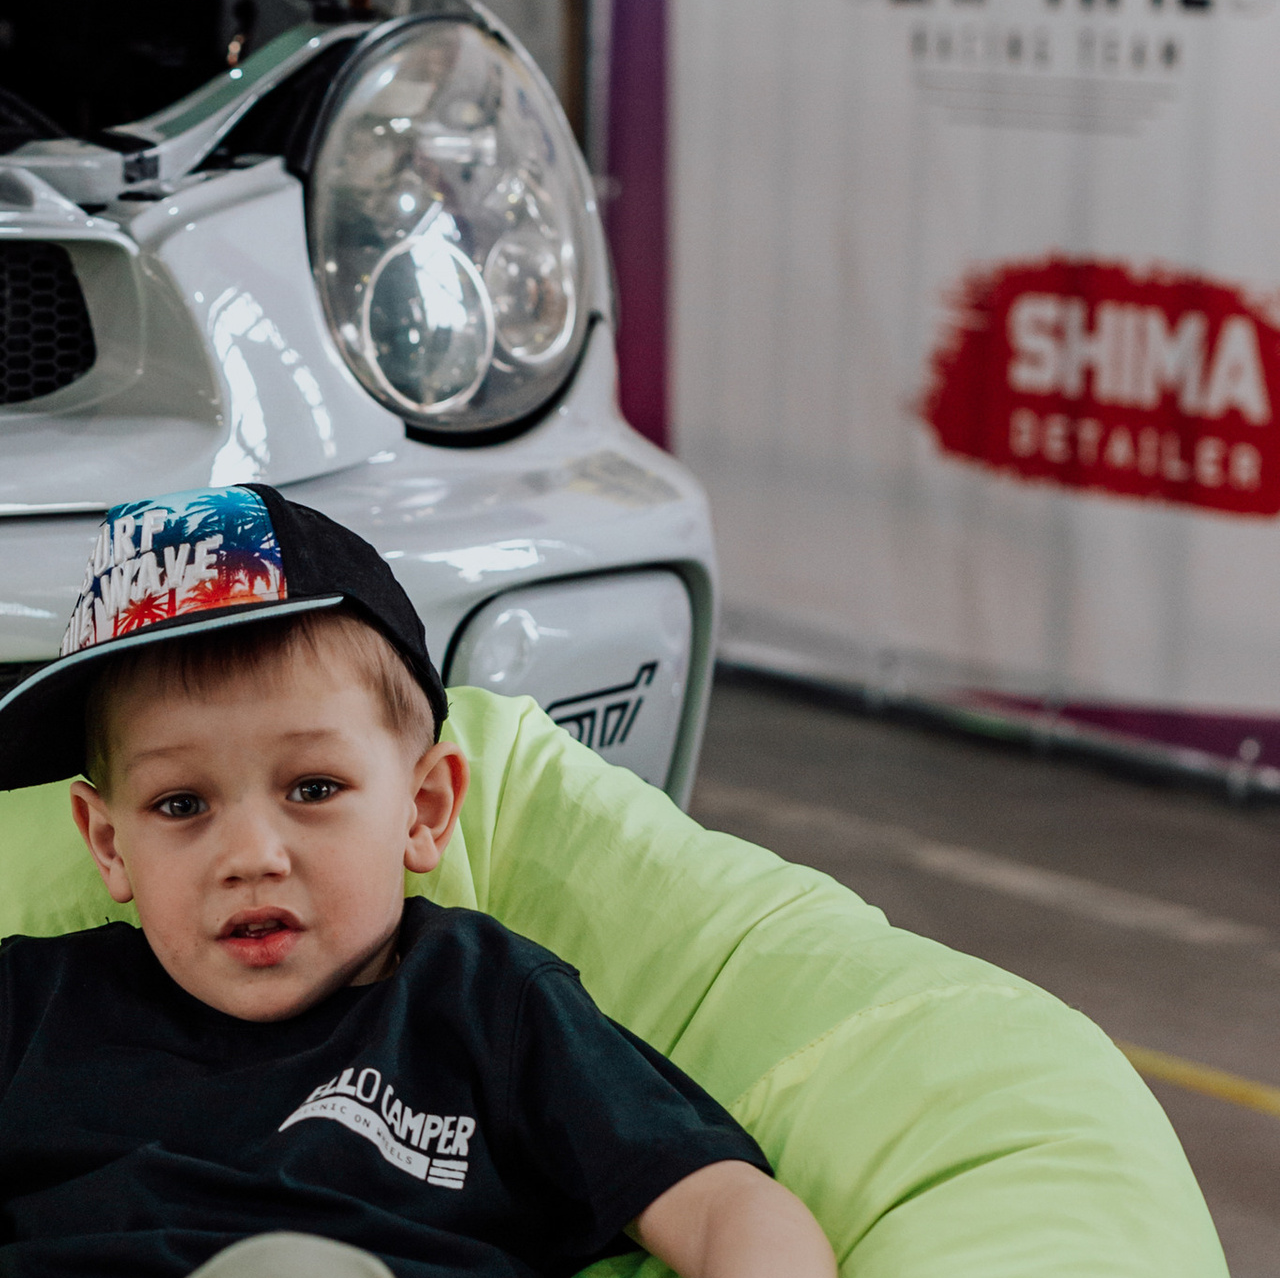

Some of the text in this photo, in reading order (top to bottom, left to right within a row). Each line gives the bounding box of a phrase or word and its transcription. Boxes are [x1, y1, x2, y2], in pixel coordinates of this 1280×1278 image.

[1006, 290, 1272, 426] SHIMA
[1008, 406, 1263, 492] DETAILER
[100, 533, 223, 621] WAVE
[354, 1113, 371, 1128] ON
[376, 1127, 413, 1165] WHEELS
[381, 1084, 476, 1156] CAMPER
